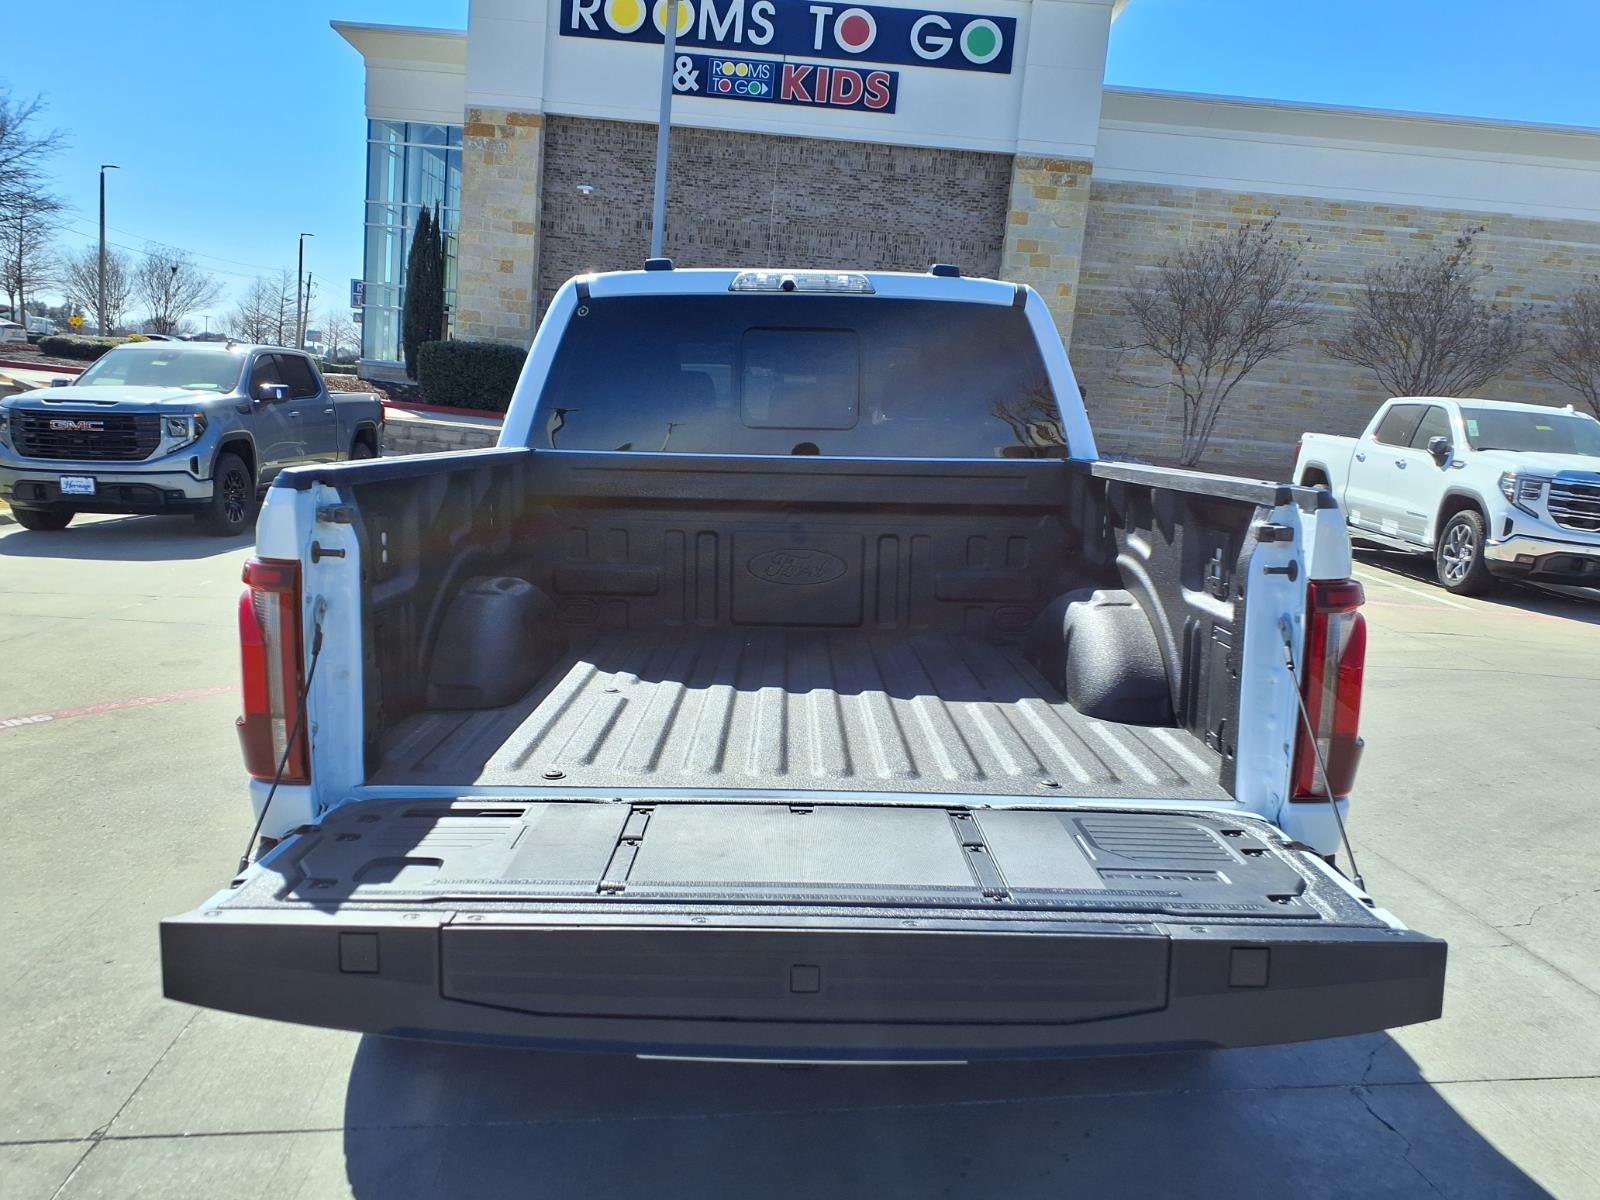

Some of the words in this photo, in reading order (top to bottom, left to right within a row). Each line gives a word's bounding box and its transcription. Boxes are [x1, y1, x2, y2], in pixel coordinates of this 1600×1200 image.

[571, 0, 776, 45] ROOMS
[809, 5, 877, 53] TO
[910, 14, 1003, 64] GO
[673, 56, 699, 92] &
[712, 60, 770, 79] ROOMS
[712, 77, 732, 93] TO
[735, 80, 761, 95] GO
[780, 63, 890, 109] KIDS
[50, 419, 104, 432] GMC
